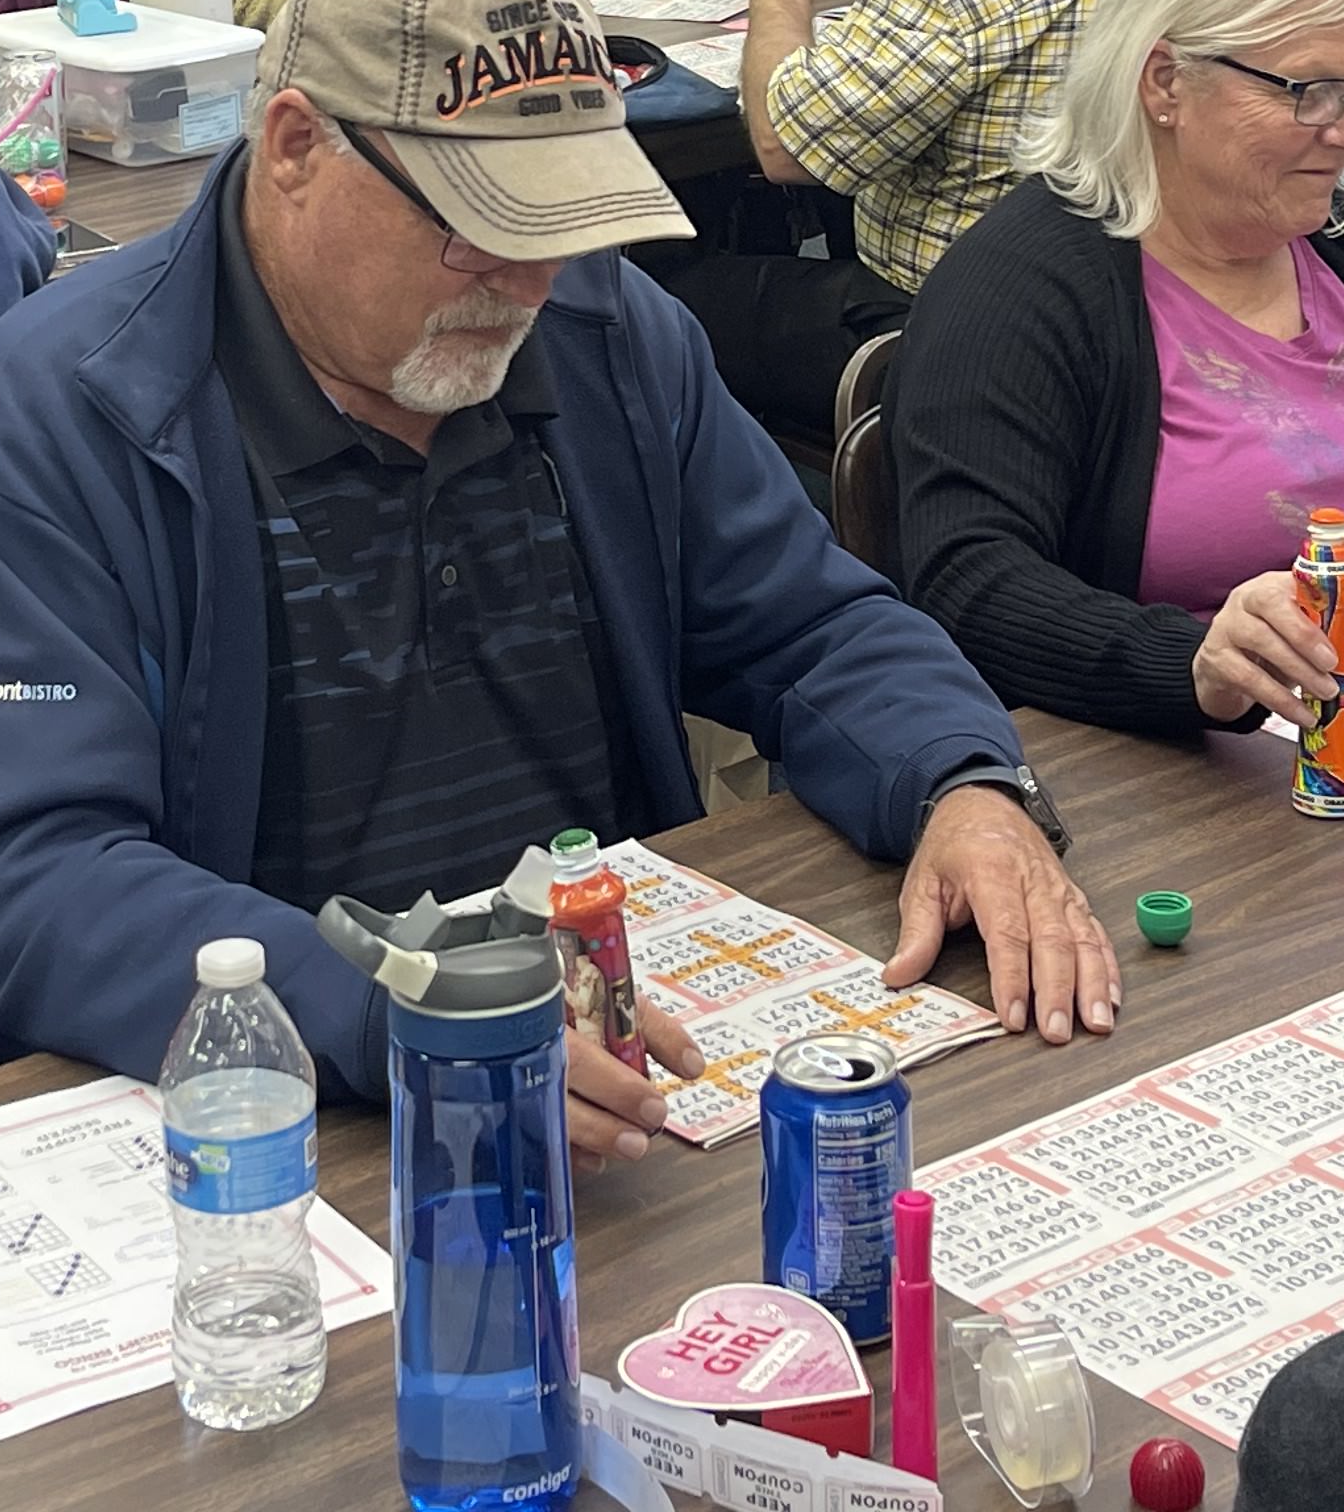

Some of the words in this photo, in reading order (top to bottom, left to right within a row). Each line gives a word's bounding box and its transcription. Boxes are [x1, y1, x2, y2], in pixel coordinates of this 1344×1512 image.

[1317, 1024, 1341, 1035] 11
[1194, 1092, 1222, 1102] 10
[1219, 1080, 1245, 1095] 27
[1247, 1070, 1274, 1083] 45
[1272, 1060, 1300, 1073] 54
[1296, 1050, 1324, 1064] 74
[1197, 1070, 1227, 1084] 23
[1223, 1060, 1252, 1073] 35
[1251, 1050, 1278, 1062] 46
[1276, 1040, 1303, 1053] 65
[1222, 1103, 1235, 1113] 7
[1242, 1091, 1271, 1104] 30
[1294, 1070, 1322, 1083] 53
[817, 1110, 866, 1130] Nutrition
[867, 1104, 896, 1126] Facts
[817, 1153, 864, 1168] Calories
[1069, 1298, 1100, 1314] 21
[1100, 1285, 1130, 1302] 40
[1130, 1273, 1159, 1288] 51
[1158, 1260, 1188, 1276] 63
[664, 1310, 737, 1362] HEY
[703, 1324, 785, 1377] GIRL
[631, 1425, 695, 1460] COUPON
[502, 1462, 573, 1504] contigo
[643, 1455, 685, 1479] KEEP
[733, 1463, 805, 1495] COUPON
[850, 1492, 930, 1512] COUPON
